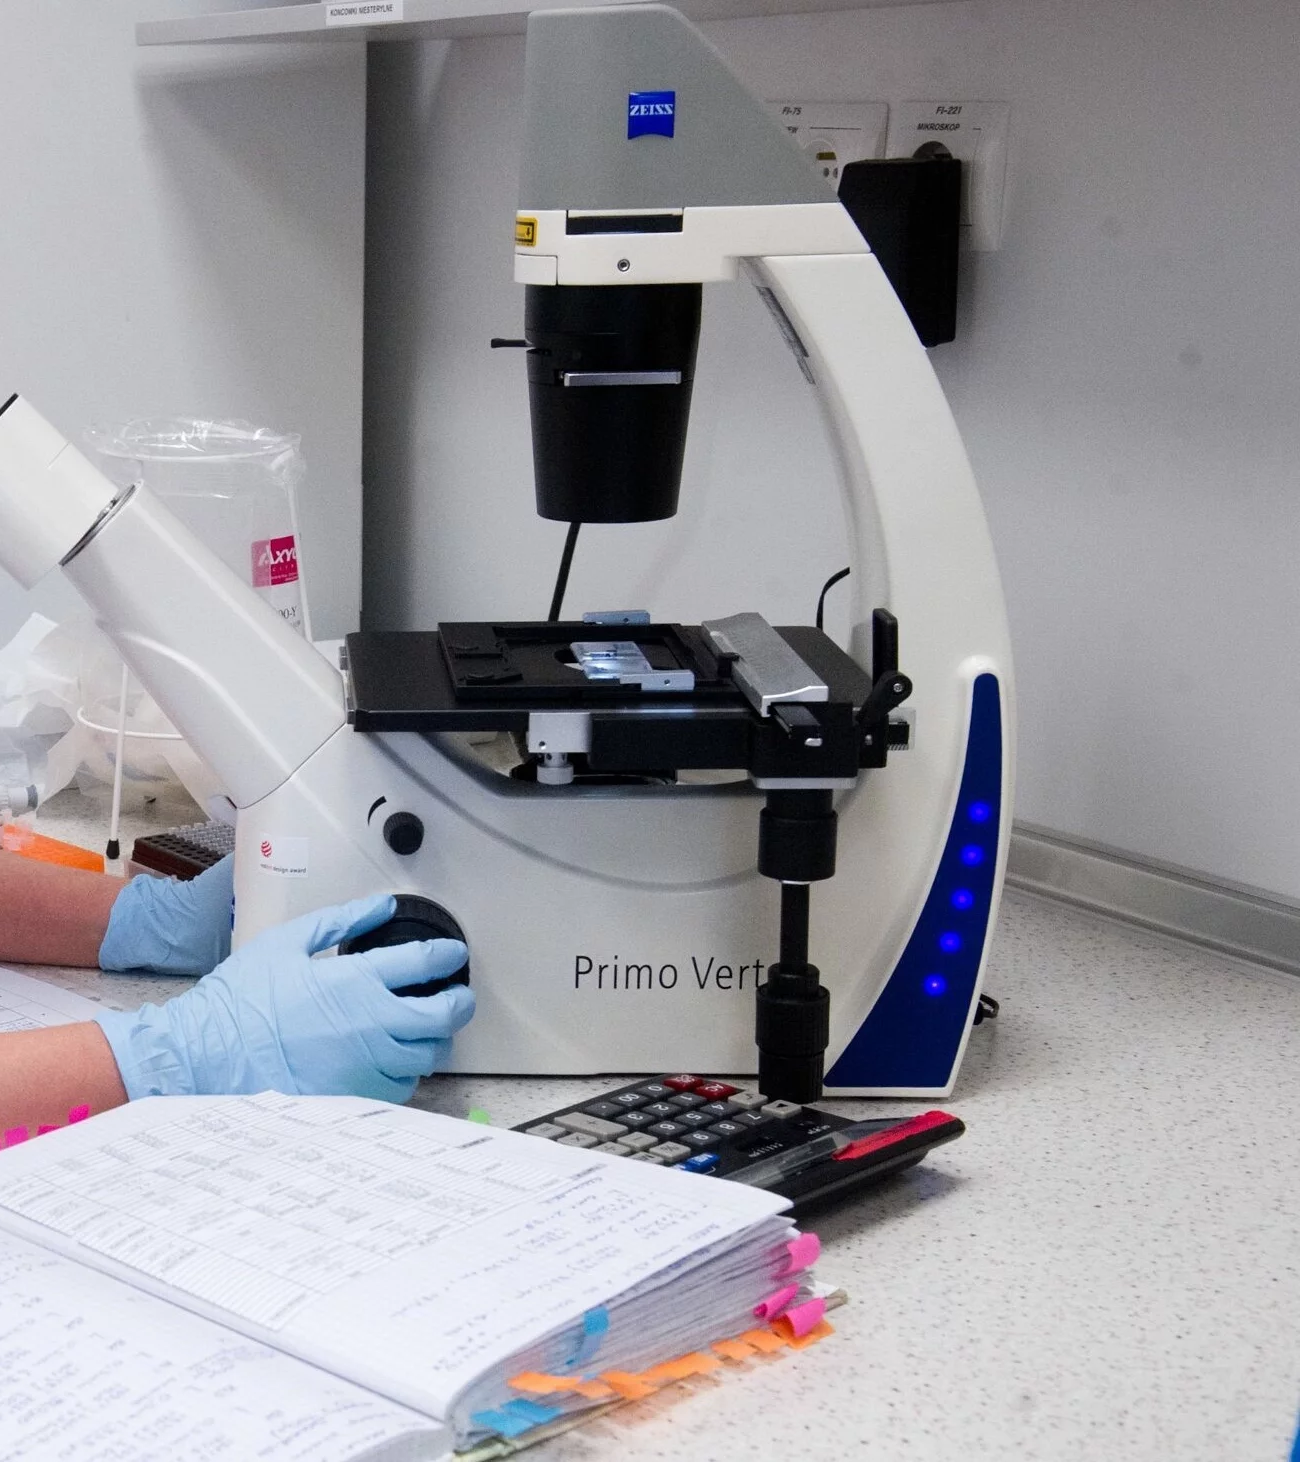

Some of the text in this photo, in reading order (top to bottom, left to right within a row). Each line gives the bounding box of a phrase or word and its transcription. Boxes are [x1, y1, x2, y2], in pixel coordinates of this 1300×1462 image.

[630, 104, 674, 116] ZEISS
[936, 106, 963, 115] FI-221
[917, 123, 961, 131] MIKROSKOP
[575, 955, 765, 990] Primo Vert
